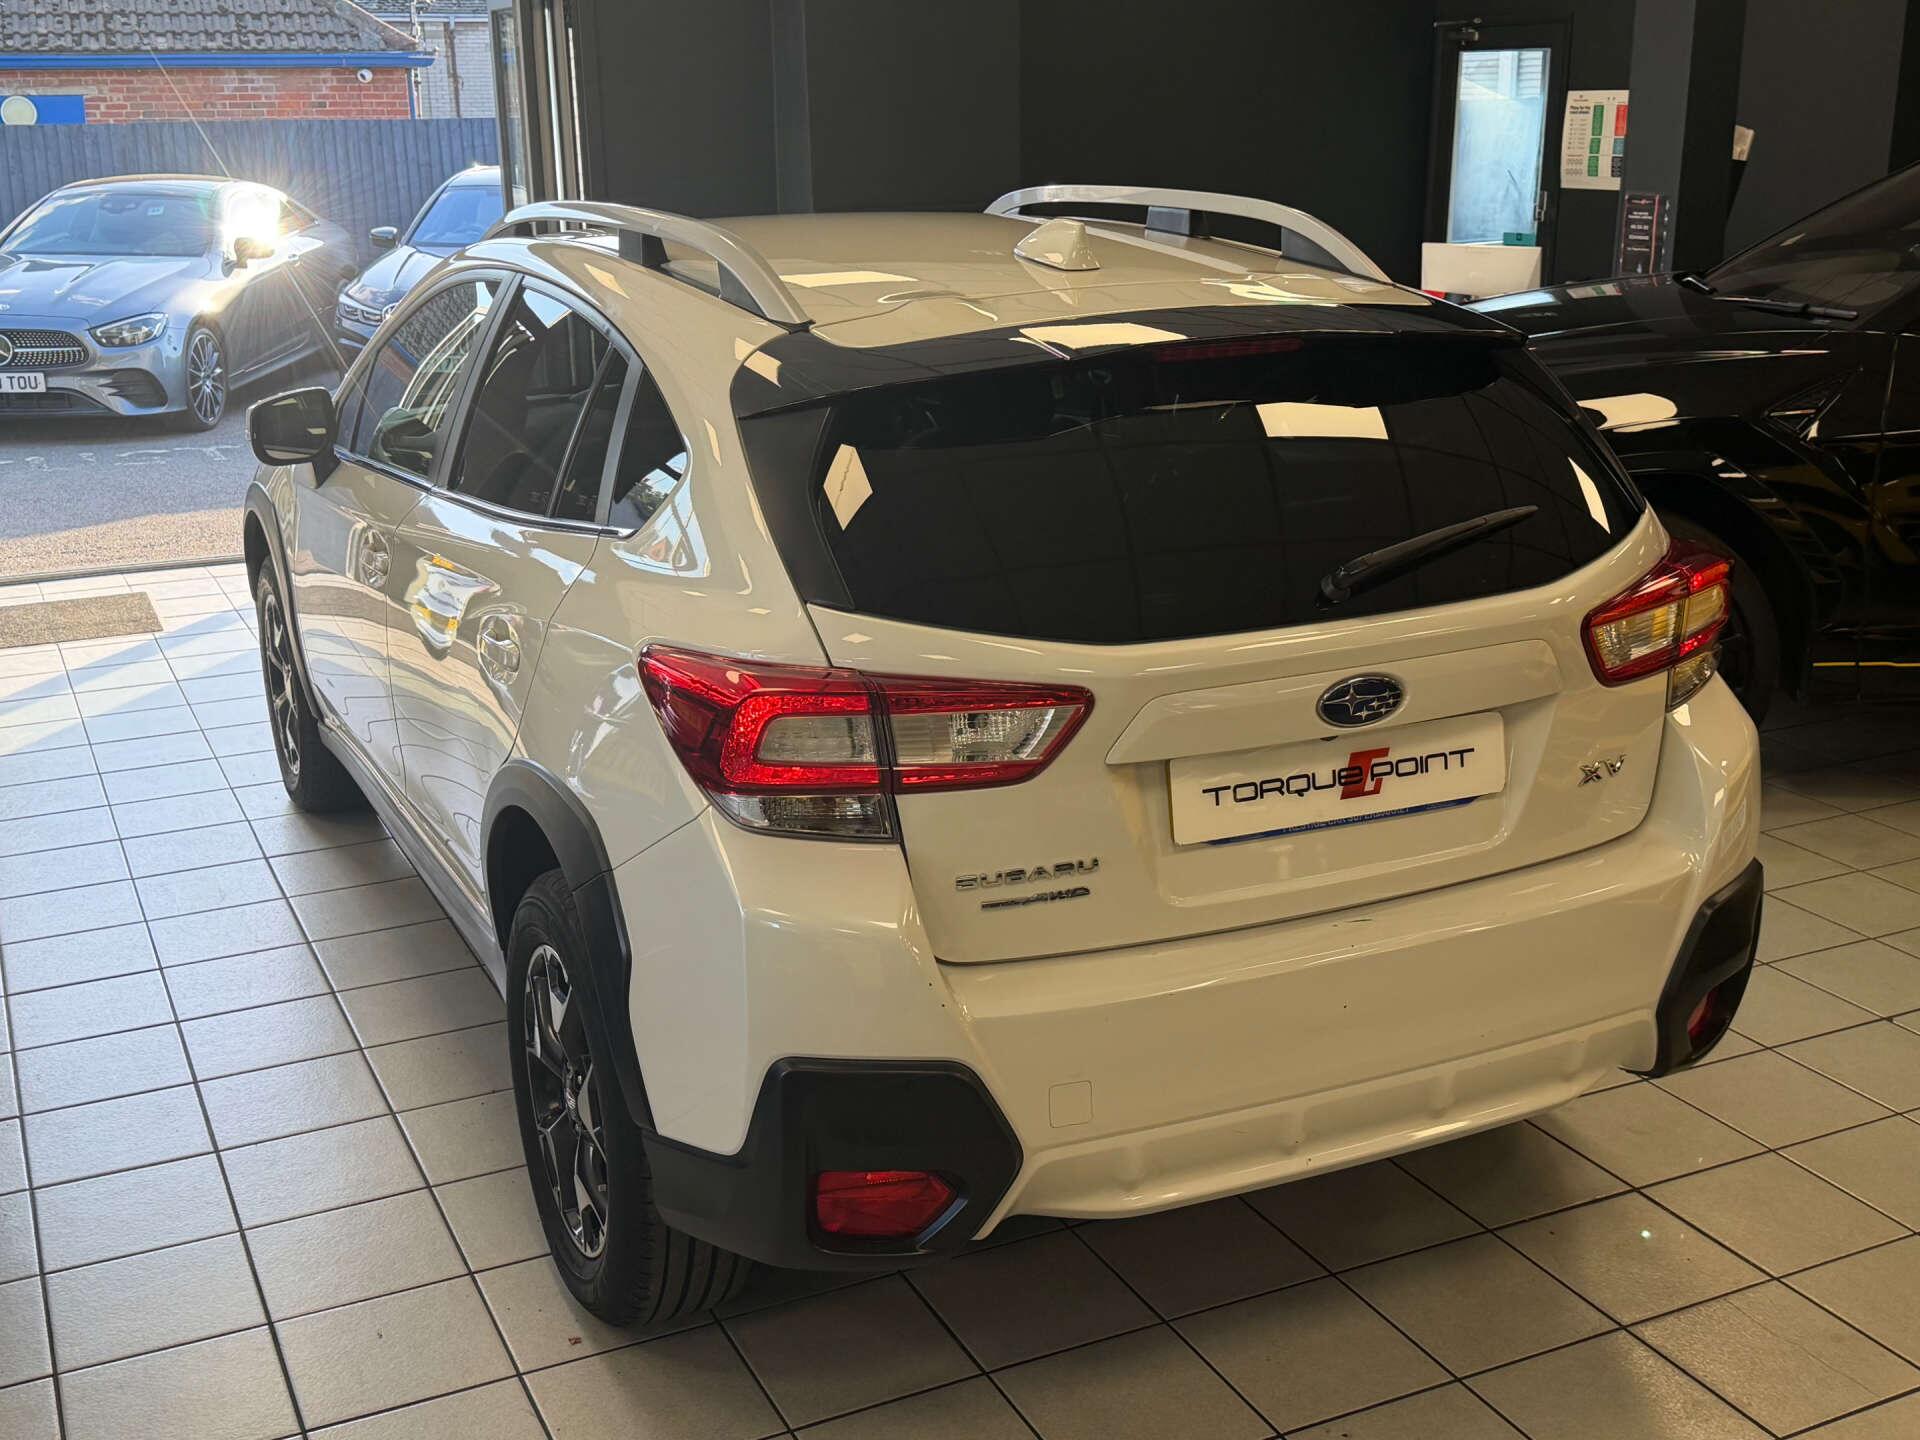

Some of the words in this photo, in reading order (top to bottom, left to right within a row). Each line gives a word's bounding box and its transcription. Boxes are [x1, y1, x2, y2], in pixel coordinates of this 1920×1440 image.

[6, 375, 39, 390] TOU
[1578, 754, 1627, 787] XV
[955, 857, 1100, 891] SUBARU
